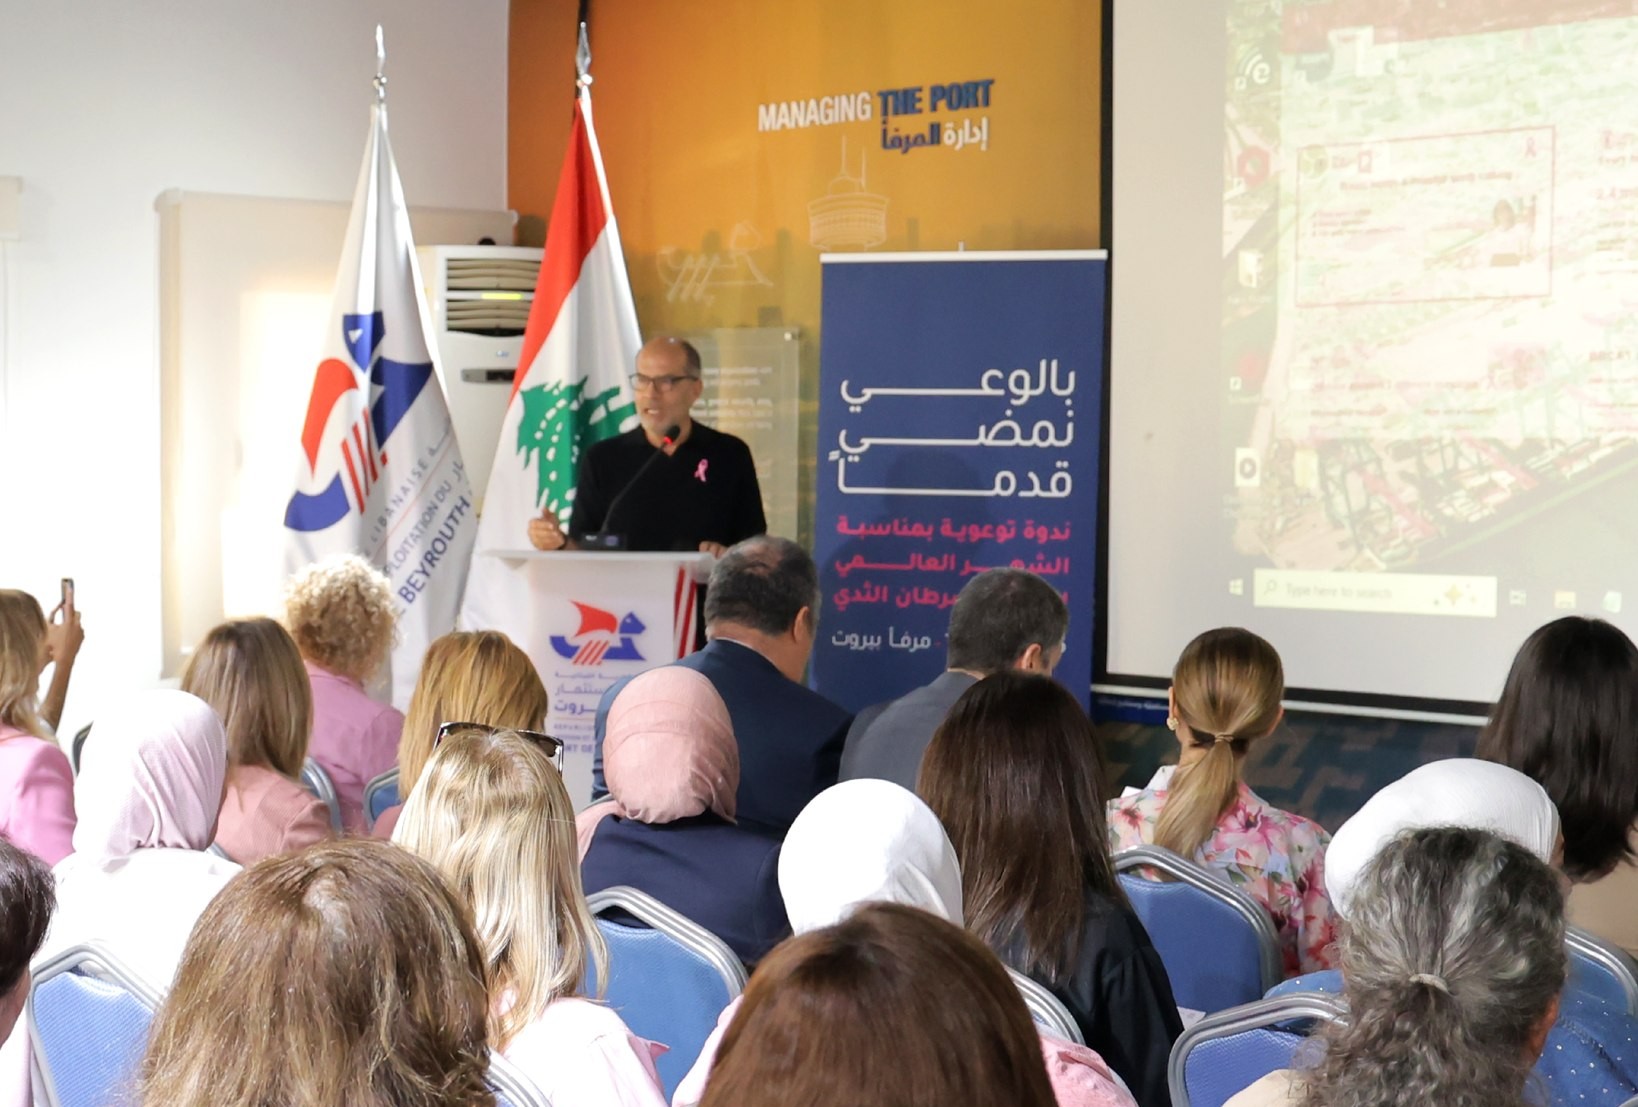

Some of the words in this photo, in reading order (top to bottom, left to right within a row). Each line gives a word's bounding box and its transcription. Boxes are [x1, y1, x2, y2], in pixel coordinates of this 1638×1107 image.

[758, 91, 872, 132] MANAGING
[877, 86, 923, 117] THE
[930, 78, 995, 112] PORT
[882, 119, 940, 154] المرفأ
[944, 116, 988, 151] إدارة
[840, 358, 1076, 413] بالوعي
[838, 409, 1075, 463] نمضي
[370, 458, 428, 543] LIBANAISE
[384, 502, 438, 577] PLOITATION
[434, 480, 452, 504] DU
[836, 515, 934, 541] بمناسبة
[940, 518, 1016, 543] توعوية
[1023, 519, 1071, 544] ندوة
[398, 495, 471, 604] BEYROUTH
[835, 552, 956, 578] العالمي
[833, 580, 888, 612] الثدي
[832, 630, 881, 651] بيروت
